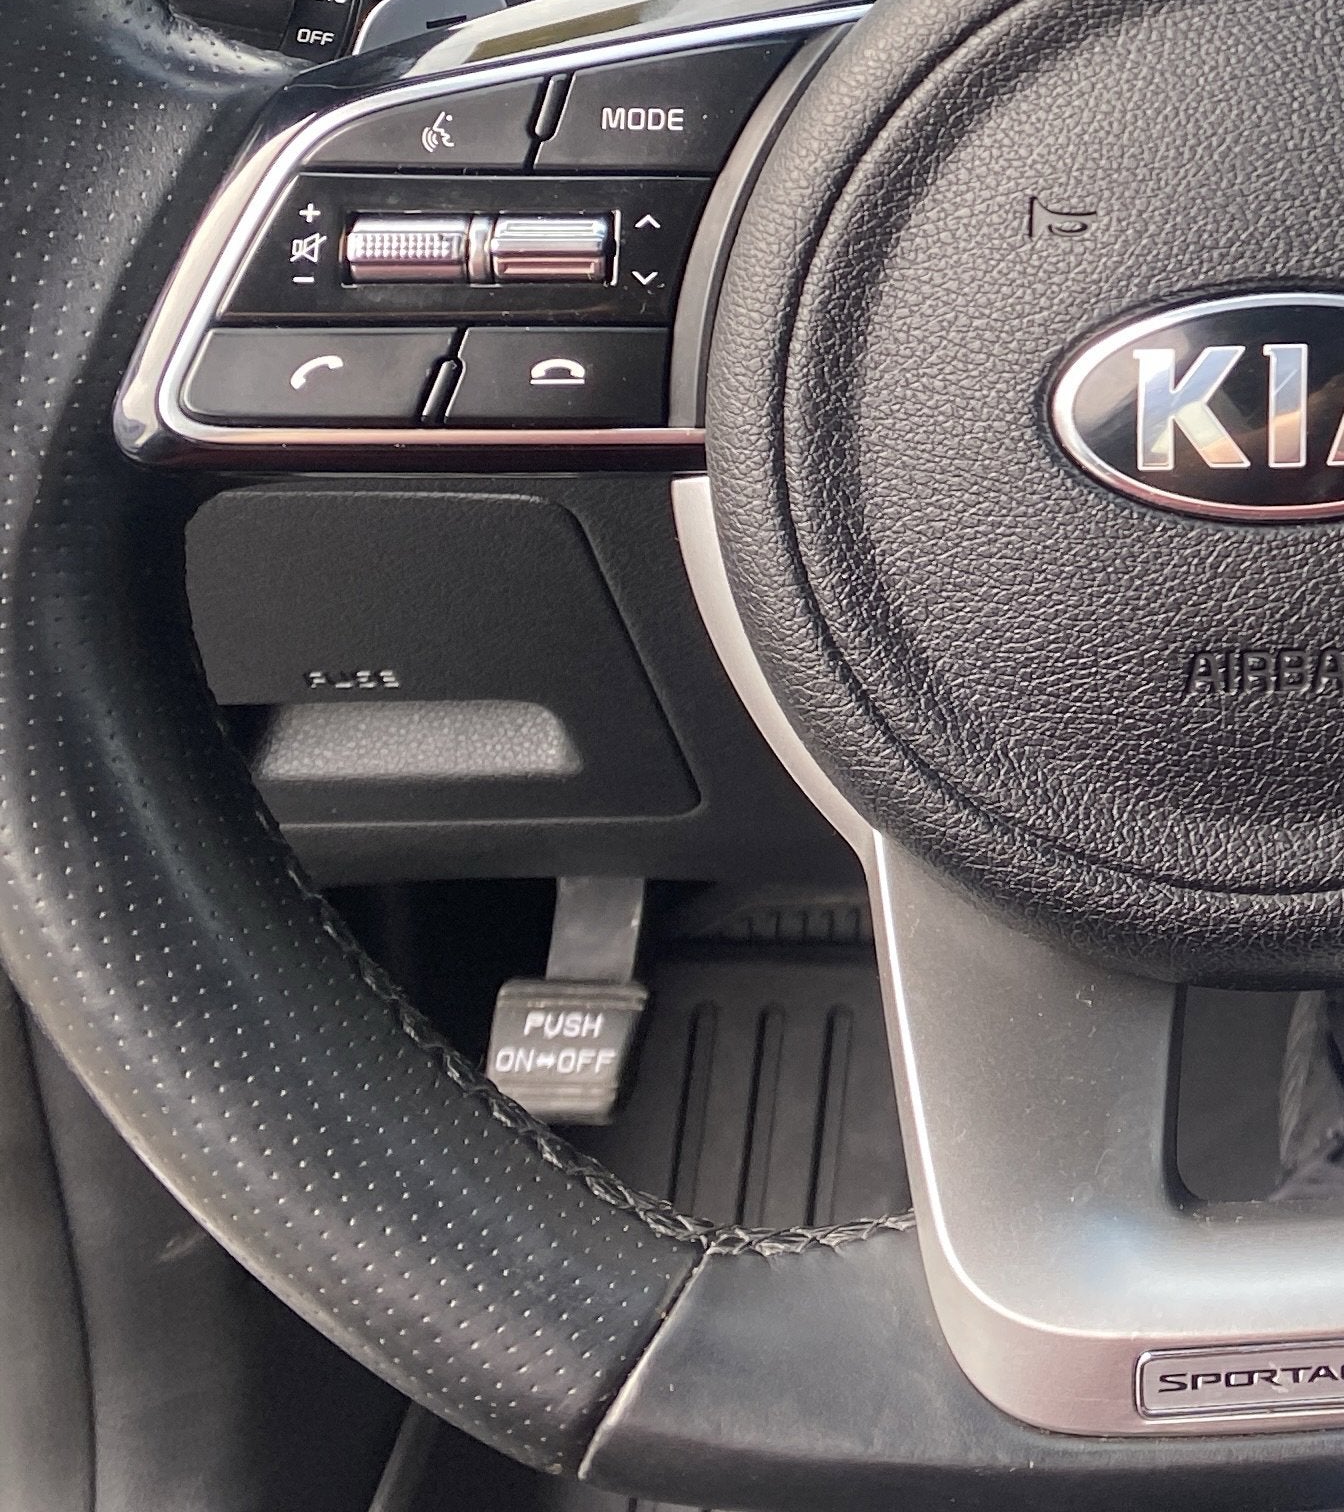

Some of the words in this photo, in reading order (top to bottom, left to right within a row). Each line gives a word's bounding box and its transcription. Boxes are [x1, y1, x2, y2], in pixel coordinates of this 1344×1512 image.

[296, 28, 335, 47] OFF
[601, 105, 685, 132] MODE
[523, 1009, 604, 1039] PUSH
[494, 1045, 535, 1074] ON
[556, 1047, 618, 1075] OFF
